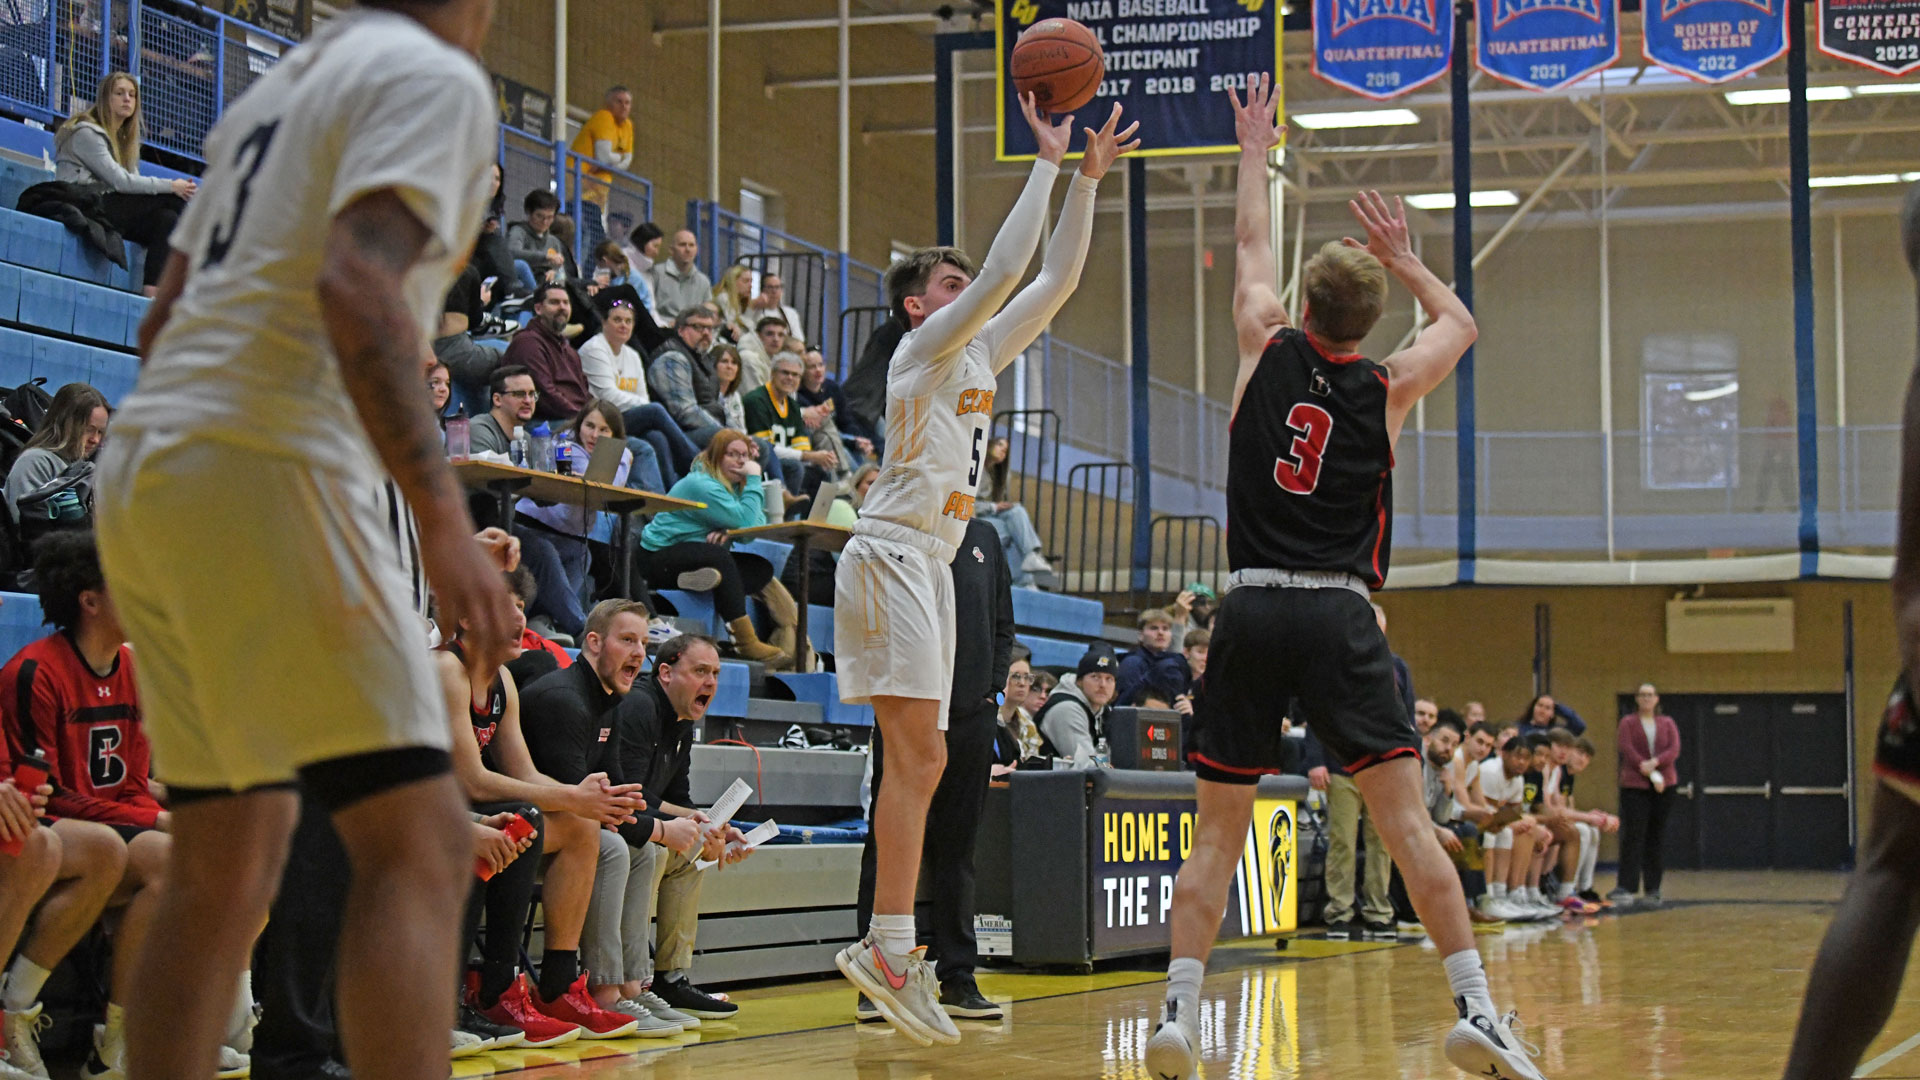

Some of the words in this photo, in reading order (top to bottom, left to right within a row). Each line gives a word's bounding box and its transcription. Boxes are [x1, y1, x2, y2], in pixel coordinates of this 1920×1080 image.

[1066, 1, 1112, 20] NAIA
[1118, 0, 1210, 17] BASEBALL
[1112, 17, 1261, 44] CHAMPIONSHIP
[1673, 22, 1733, 38] ROUND
[1737, 20, 1760, 35] OF
[1323, 43, 1443, 63] QUARTERFINAL
[1487, 33, 1608, 55] QUARTERFINAL
[1681, 34, 1752, 51] SIXTEEN
[1875, 44, 1919, 62] 2022
[1103, 48, 1200, 72] RTICIPANT
[1698, 54, 1737, 72] 2022
[1365, 71, 1401, 88] 2019
[1529, 63, 1567, 81] 2021
[1095, 78, 1132, 97] 017
[1145, 76, 1196, 95] 2018
[199, 116, 281, 271] 3
[968, 426, 984, 488] 5
[1273, 402, 1334, 496] 3
[1104, 812, 1171, 863] HOME
[1179, 812, 1199, 862] O
[1103, 875, 1150, 928] THE
